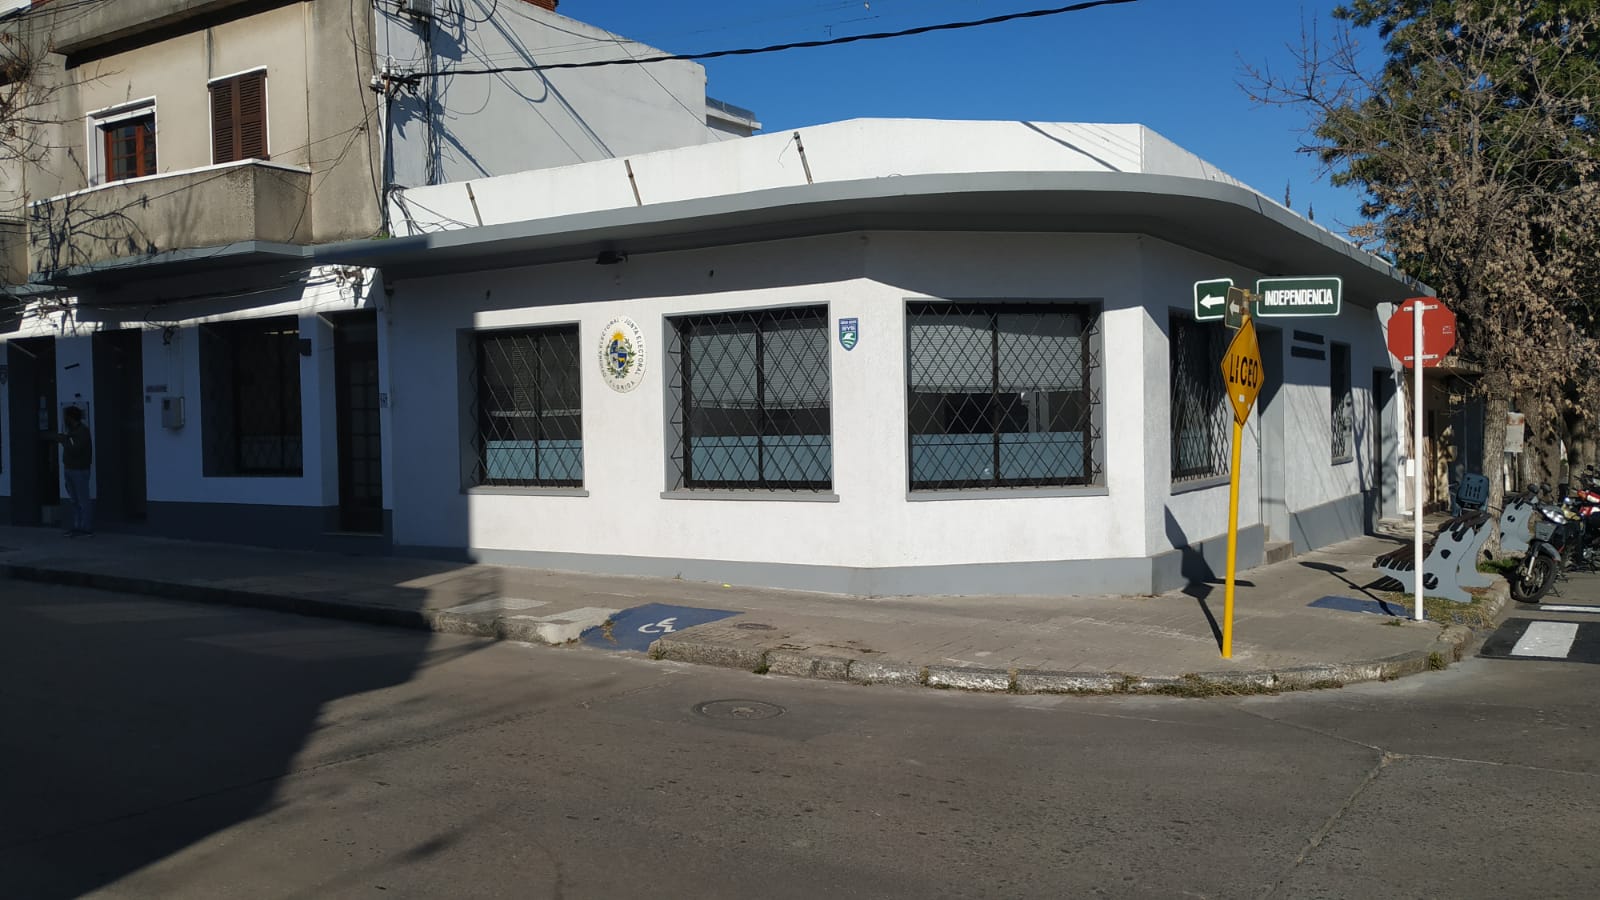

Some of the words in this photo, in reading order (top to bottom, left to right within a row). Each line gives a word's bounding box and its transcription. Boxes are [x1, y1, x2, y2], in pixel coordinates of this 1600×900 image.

[1264, 288, 1334, 306] INDEPENDENCIA
[624, 318, 640, 336] JUNTA
[635, 335, 644, 375] ELECTORAL
[1229, 353, 1259, 389] LICEO
[609, 380, 635, 390] FLORIDA
